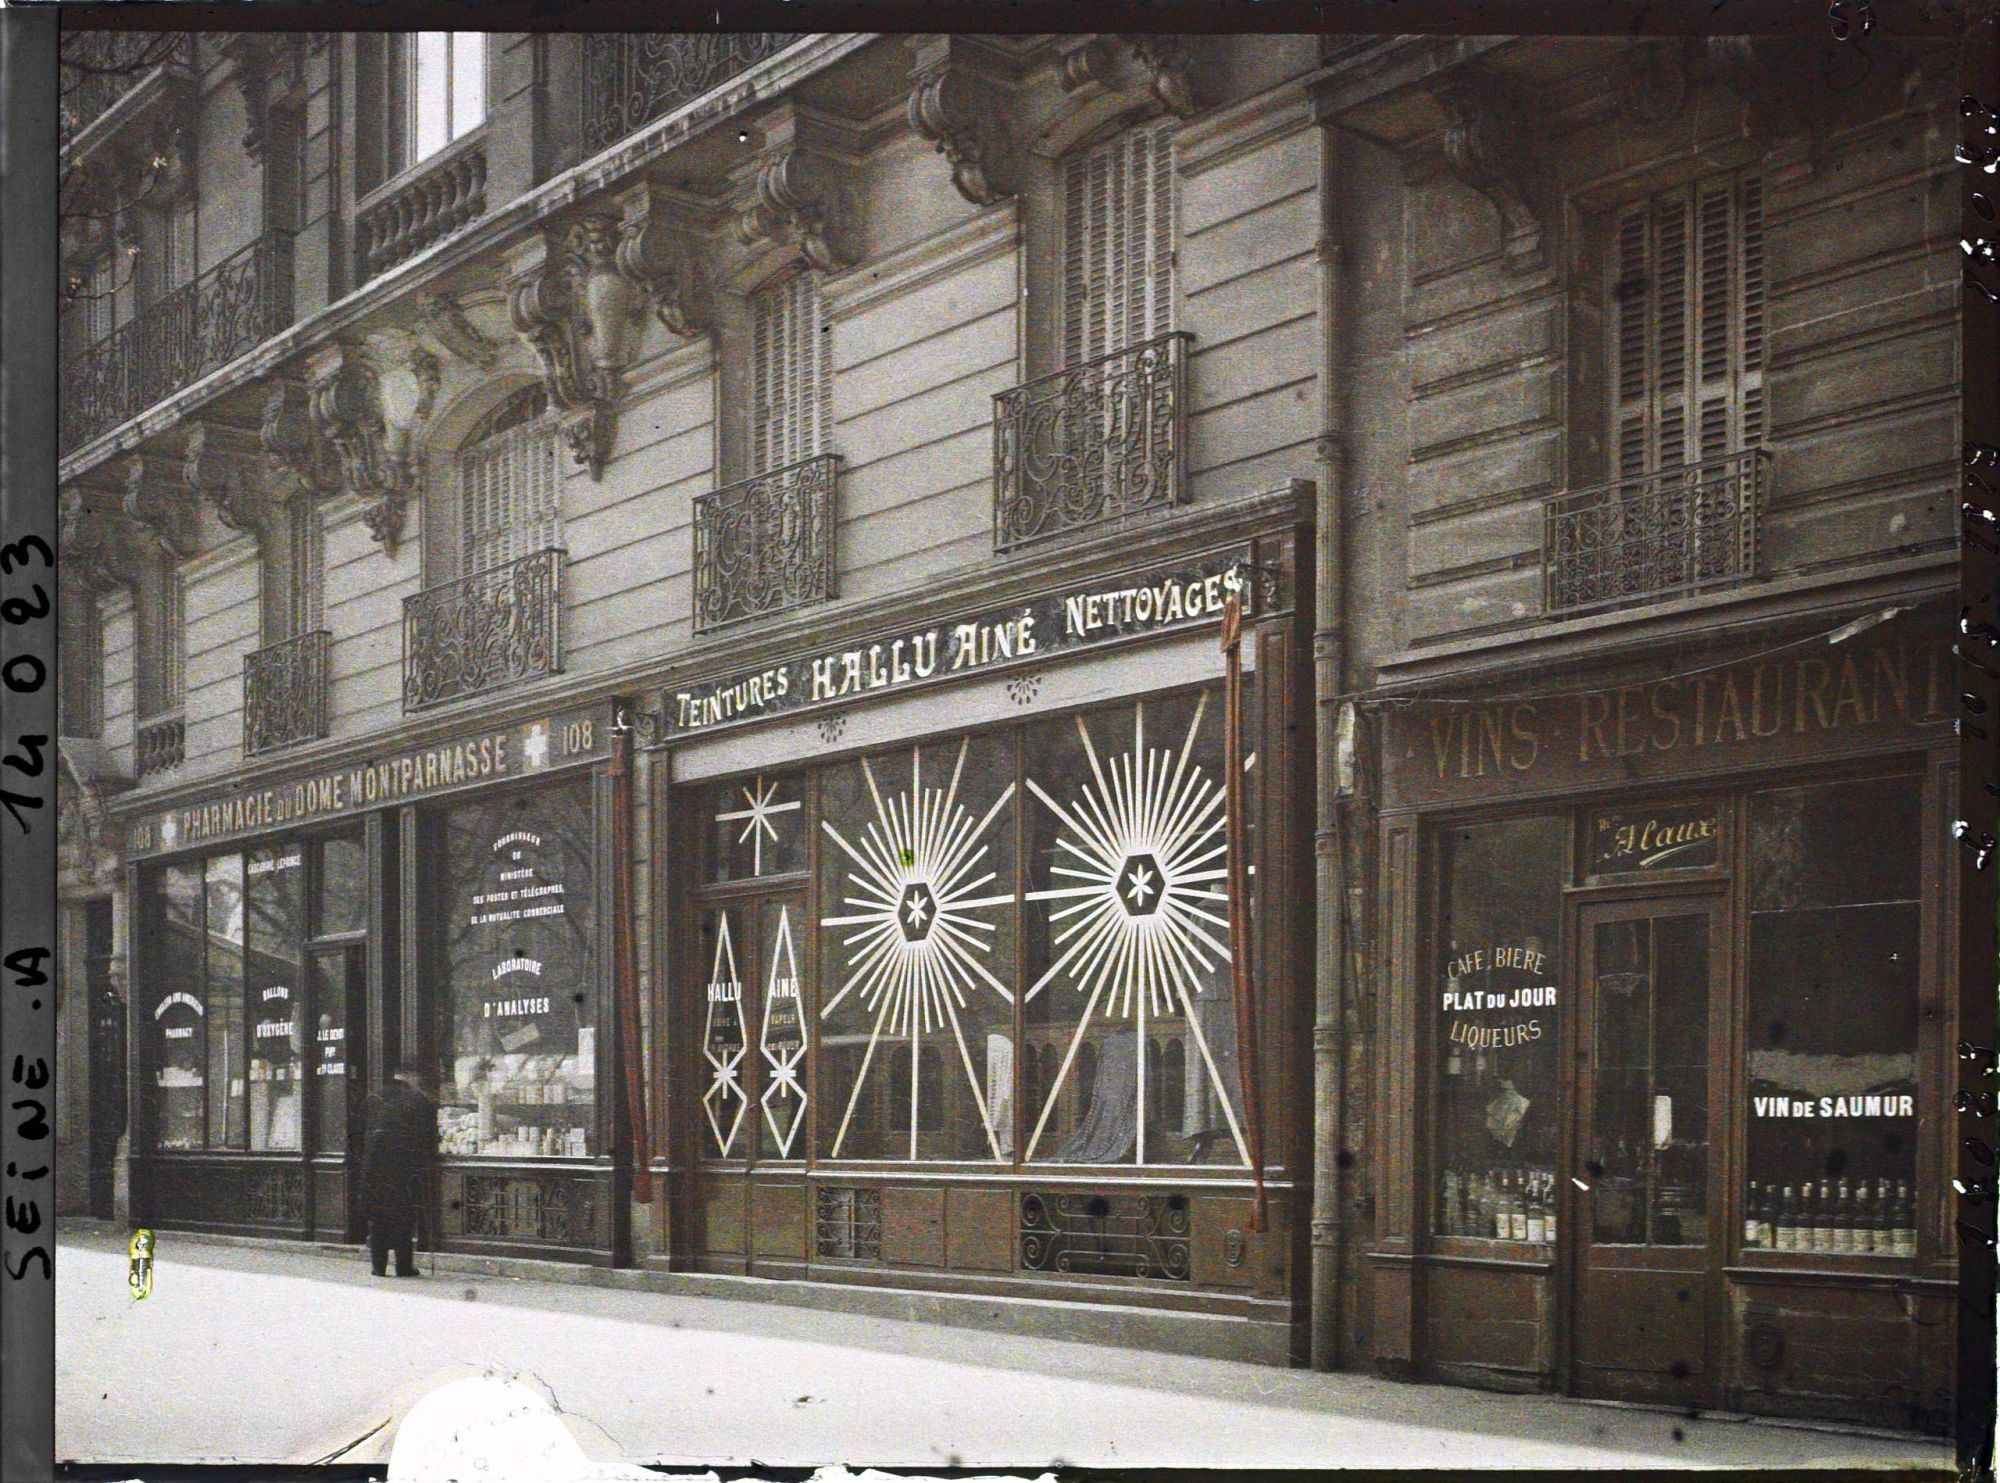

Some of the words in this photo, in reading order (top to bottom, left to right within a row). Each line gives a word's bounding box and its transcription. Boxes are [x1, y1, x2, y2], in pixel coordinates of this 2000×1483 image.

[676, 664, 789, 729] TEINTURES
[810, 634, 937, 702] HALLU
[953, 608, 1036, 669] AINÉ
[1064, 564, 1244, 637] NETTOYAGES
[1430, 703, 1538, 780] VINS
[1577, 640, 1952, 763] RESTAURANT
[562, 720, 594, 756] 108
[183, 791, 273, 841] PHARMACIE
[277, 797, 292, 821] DU
[295, 775, 344, 816] DOME
[349, 733, 509, 802] MONTPARNASSE
[493, 831, 541, 852] FOURNISSEUR
[480, 914, 487, 924] LA
[492, 957, 543, 980] LABORATOIRE
[707, 982, 742, 1002] HALLU
[1443, 991, 1485, 1011] PLAT
[1487, 993, 1507, 1009] DU
[1509, 986, 1557, 1008] JOUR
[484, 997, 550, 1018] D'ANALYSES
[1450, 1019, 1542, 1051] LIQUEURS
[1754, 1097, 1790, 1118] VIN
[1792, 1101, 1815, 1118] DE
[1819, 1095, 1914, 1118] SAUMUR
